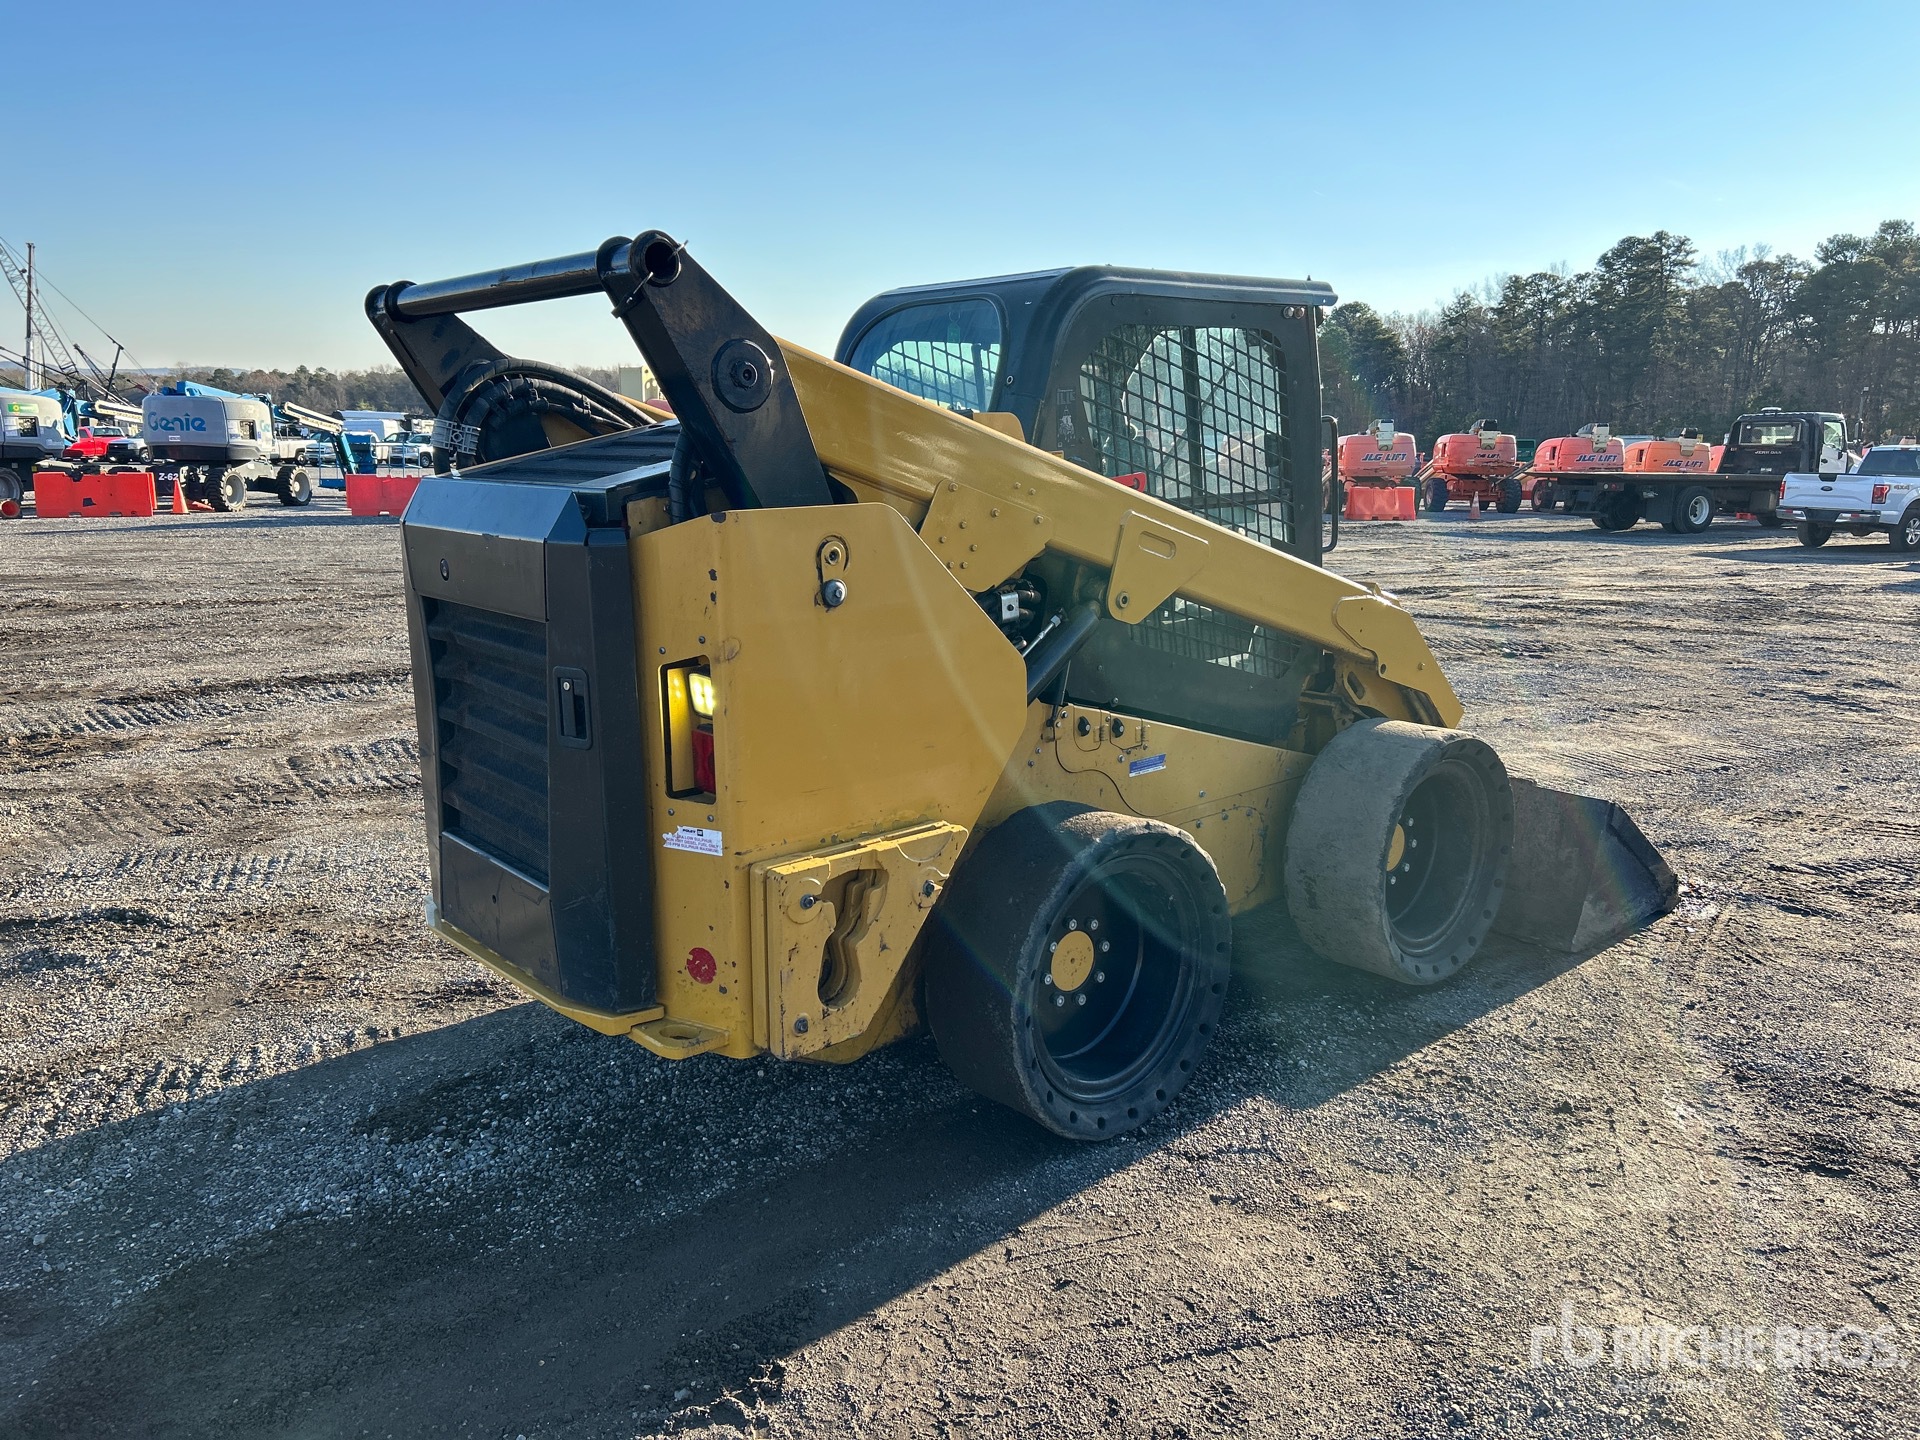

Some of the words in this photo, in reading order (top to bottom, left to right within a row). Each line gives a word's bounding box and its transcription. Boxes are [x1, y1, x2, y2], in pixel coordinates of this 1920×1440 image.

[148, 411, 206, 432] Genie
[1361, 453, 1383, 461] JLG
[1385, 453, 1407, 461] LIFT
[1575, 454, 1595, 462] JLG
[1598, 454, 1617, 462] LIFT
[1663, 459, 1682, 467] JLG
[1685, 460, 1703, 468] LIFT
